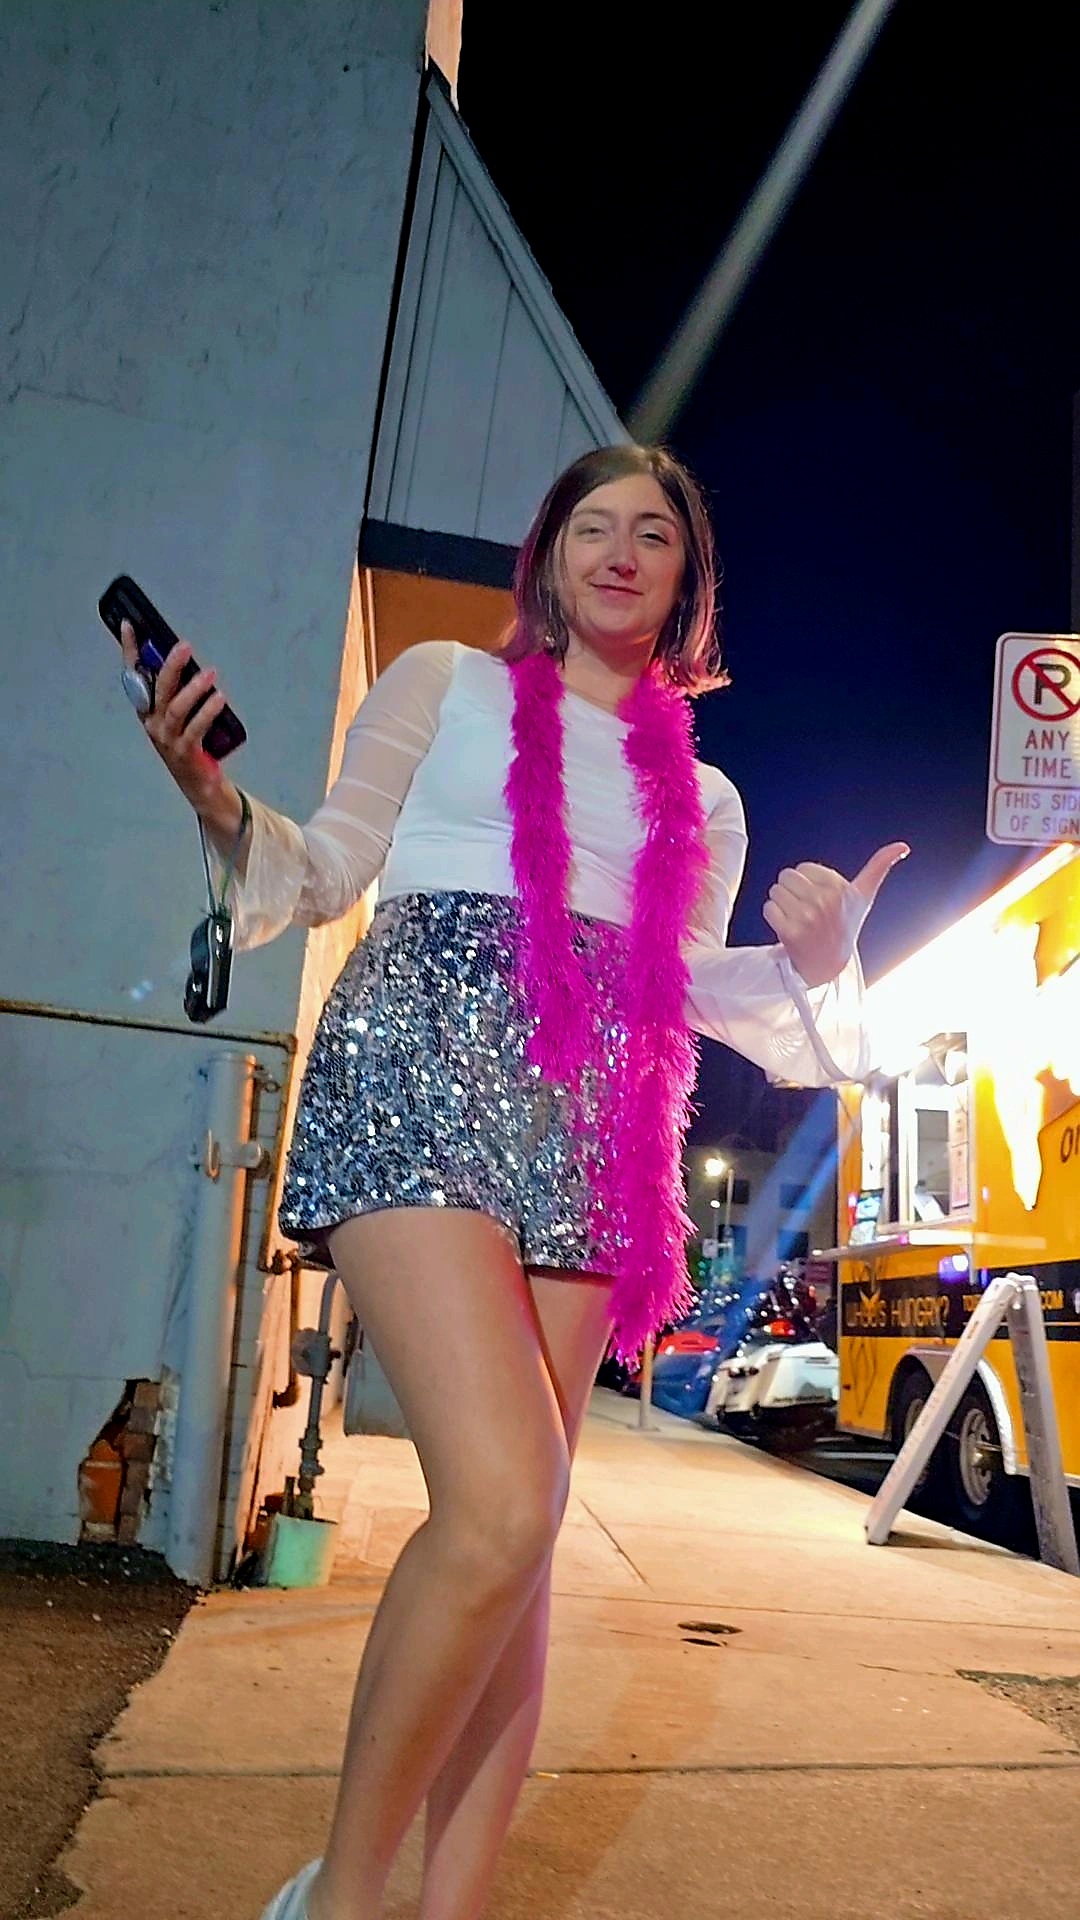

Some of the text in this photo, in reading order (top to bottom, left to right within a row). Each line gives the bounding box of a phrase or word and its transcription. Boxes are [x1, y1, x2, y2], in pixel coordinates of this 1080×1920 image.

[1025, 729, 1070, 751] ANY
[1022, 756, 1072, 779] TIME
[1004, 791, 1080, 812] THIS SID
[1010, 815, 1080, 835] OF SIGN
